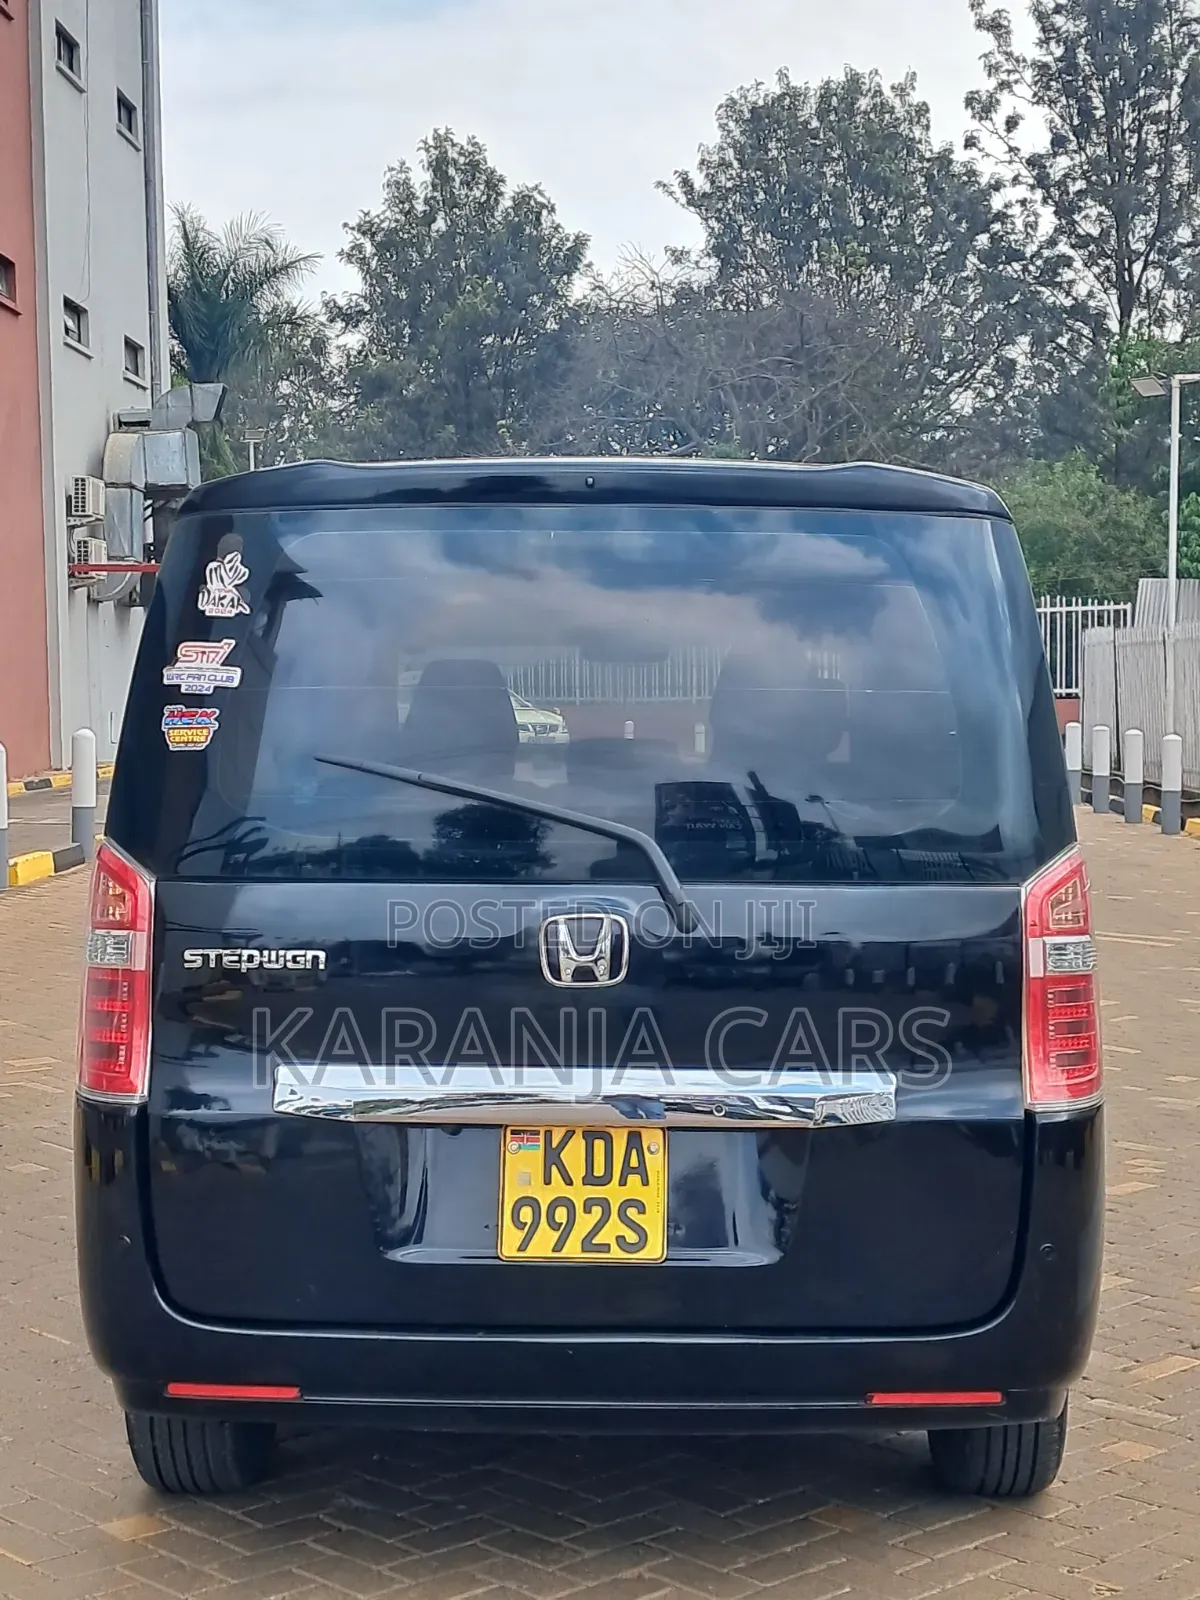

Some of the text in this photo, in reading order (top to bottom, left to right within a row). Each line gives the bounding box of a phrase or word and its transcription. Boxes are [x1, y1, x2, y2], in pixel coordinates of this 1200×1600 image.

[199, 586, 249, 612] DAKAR
[166, 673, 235, 683] WRC FAN CLUB
[184, 684, 212, 692] 2024
[543, 1130, 649, 1187] KDA
[511, 1196, 648, 1254] 992S
